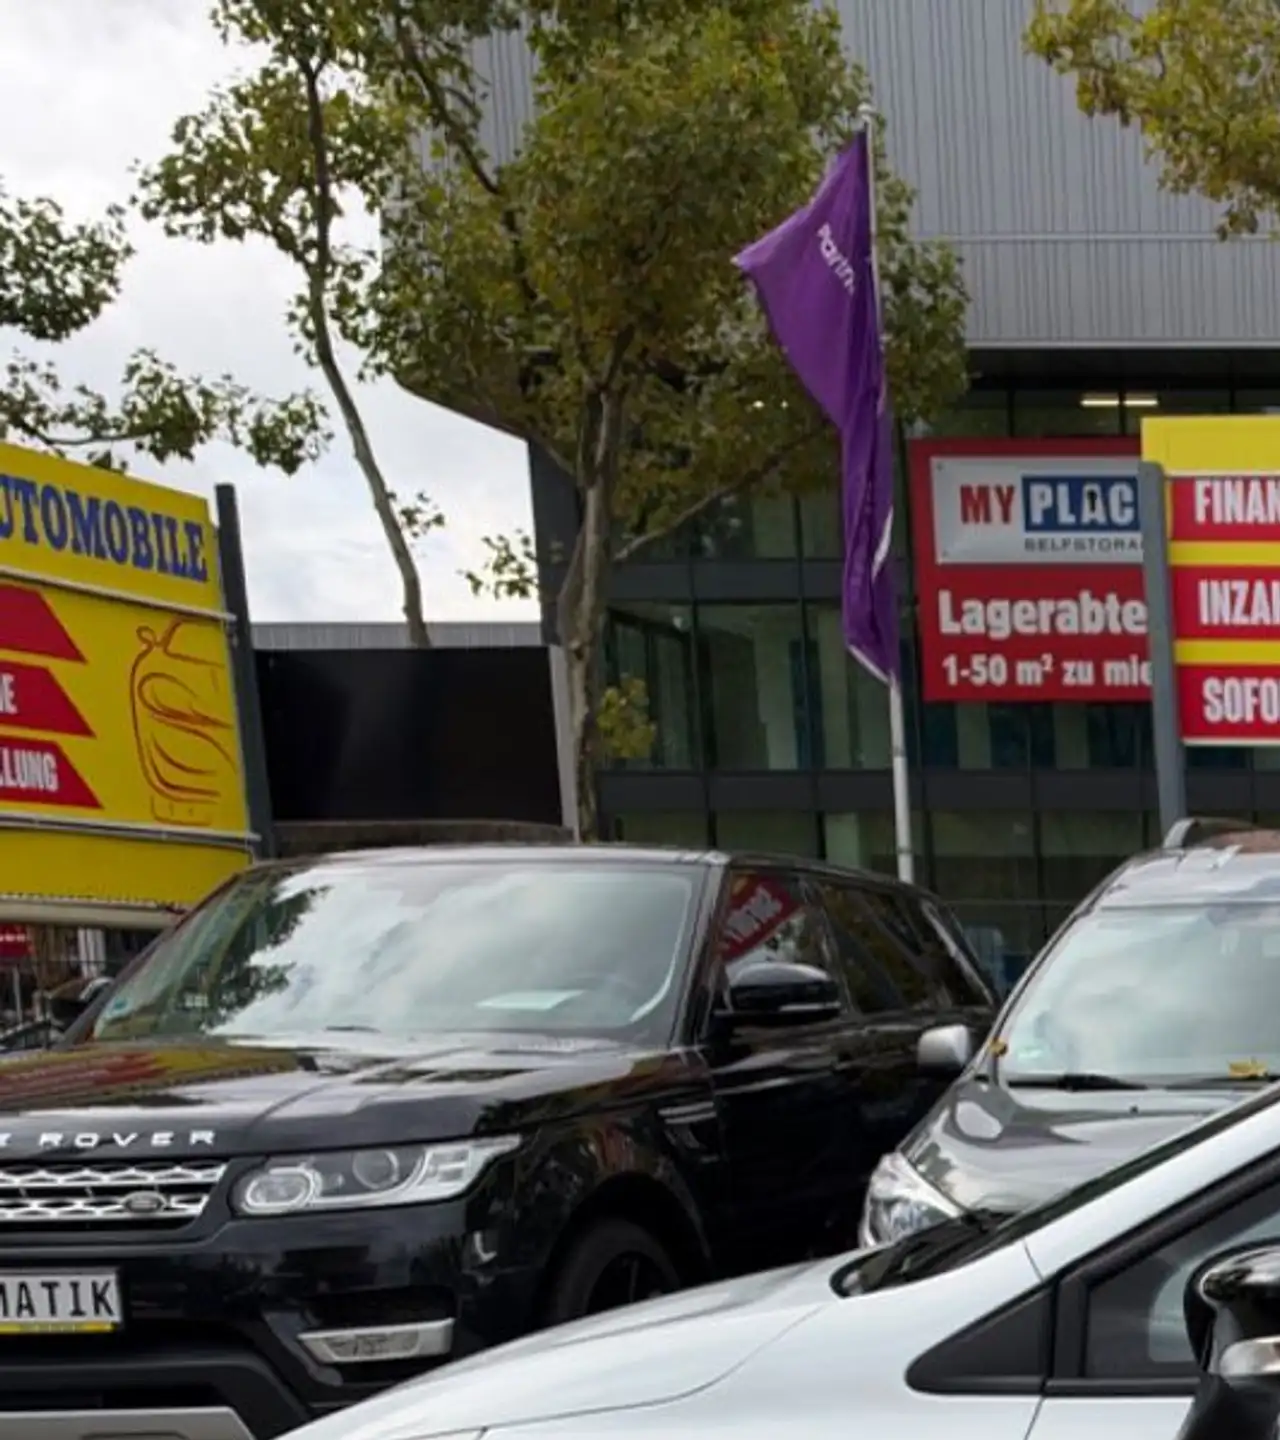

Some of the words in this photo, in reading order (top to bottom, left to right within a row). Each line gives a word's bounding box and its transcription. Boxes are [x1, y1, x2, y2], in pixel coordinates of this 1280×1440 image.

[960, 484, 1015, 524] MY
[938, 589, 1148, 640] Lagerabte
[942, 654, 1007, 685] 1-50
[1062, 661, 1095, 686] zu
[38, 1129, 216, 1148] ROVER
